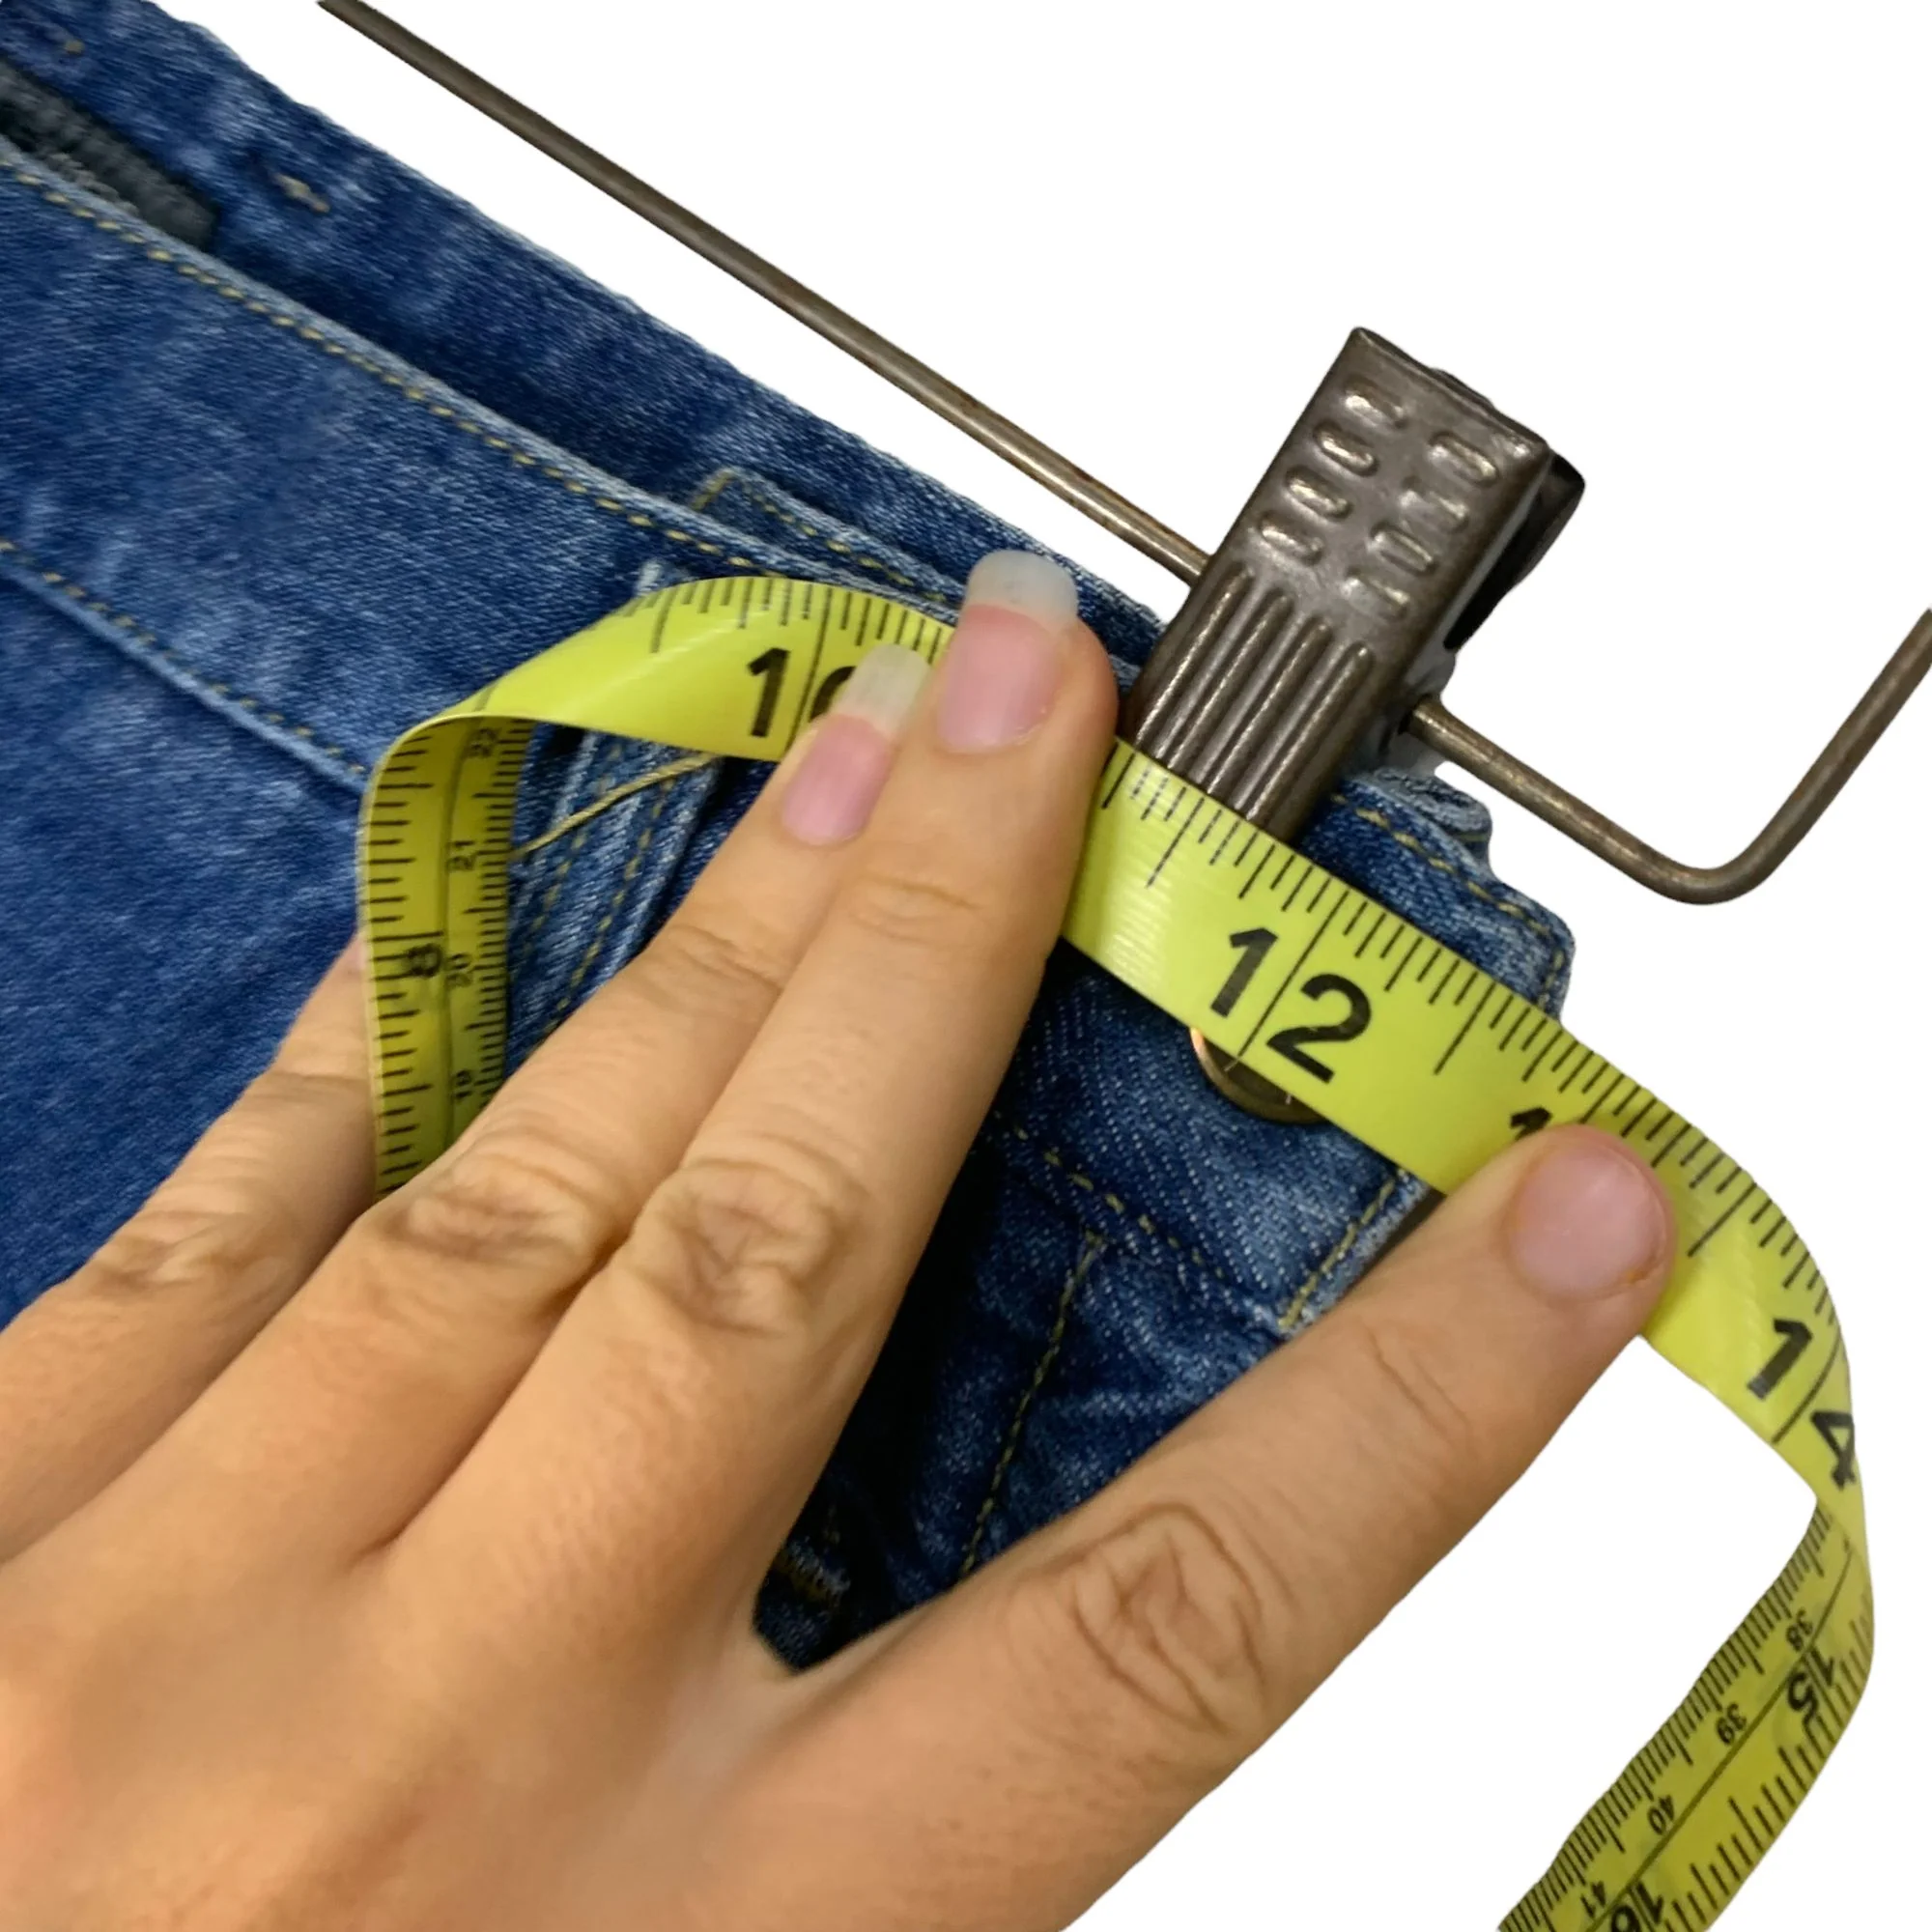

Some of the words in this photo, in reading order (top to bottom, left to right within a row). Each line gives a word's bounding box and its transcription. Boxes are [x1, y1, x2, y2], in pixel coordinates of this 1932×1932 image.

[747, 646, 857, 739] 1
[1210, 927, 1371, 1084] 12
[1747, 1318, 1856, 1492] 14
[1786, 1609, 1814, 1652] 38
[1787, 1646, 1835, 1726] 15
[1716, 1702, 1747, 1746] 39
[1647, 1796, 1675, 1835] 40
[1580, 1881, 1605, 1918] 41
